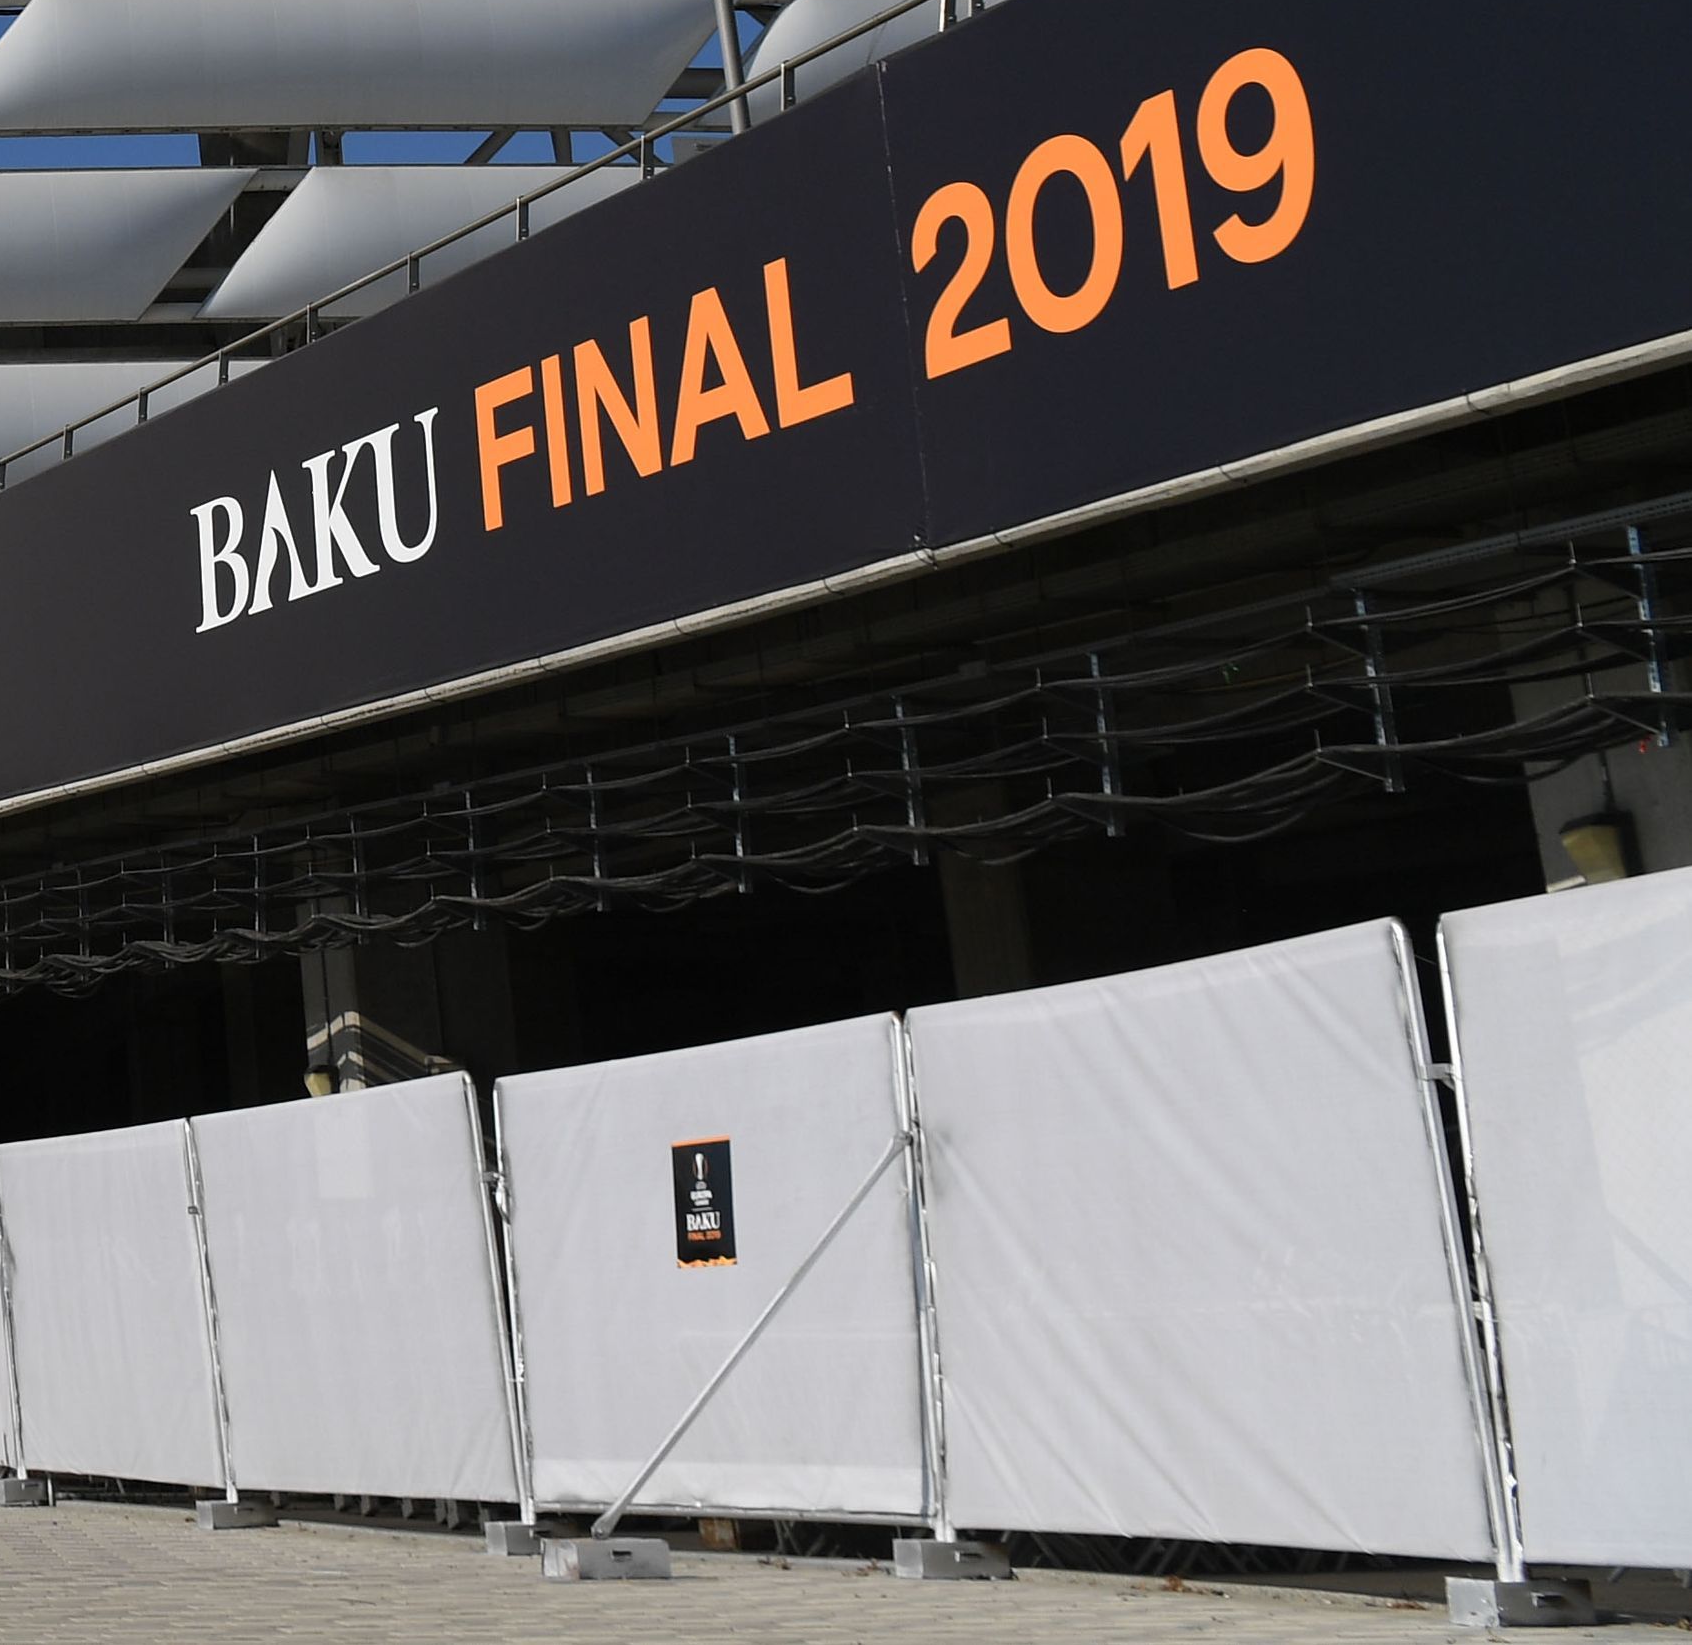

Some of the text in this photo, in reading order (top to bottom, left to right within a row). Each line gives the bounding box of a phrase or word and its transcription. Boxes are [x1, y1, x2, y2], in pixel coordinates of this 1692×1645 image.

[190, 48, 1316, 634] BAKU FINAL 2019
[686, 1212, 721, 1231] BAKU
